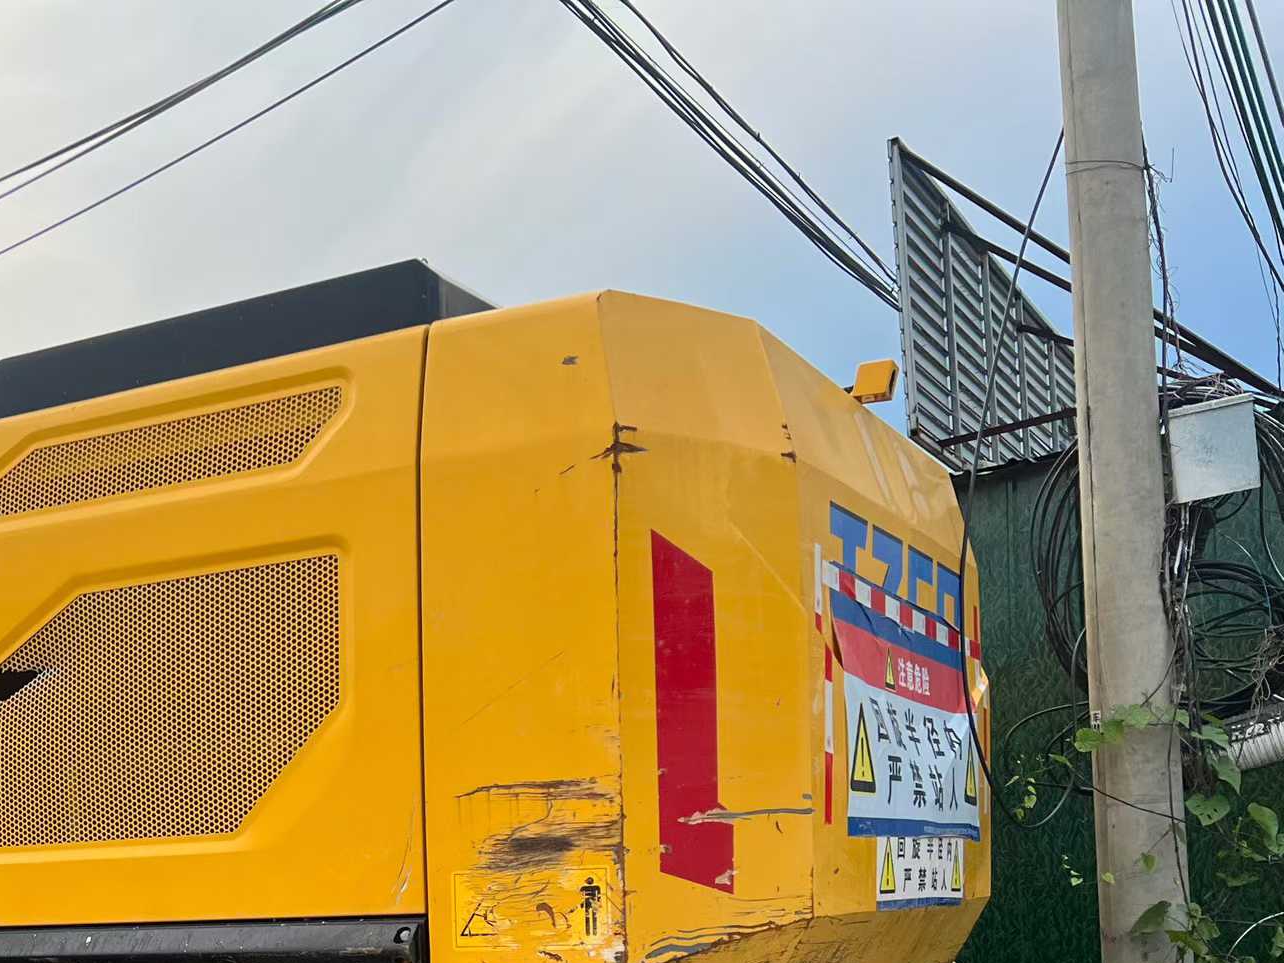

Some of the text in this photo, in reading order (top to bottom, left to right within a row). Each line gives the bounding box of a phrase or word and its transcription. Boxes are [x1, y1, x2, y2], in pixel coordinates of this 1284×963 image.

[897, 657, 931, 696] 注意危险
[868, 696, 963, 761] 回旋半径内
[887, 754, 958, 812] 严禁站人
[902, 866, 947, 893] 严禁站人
